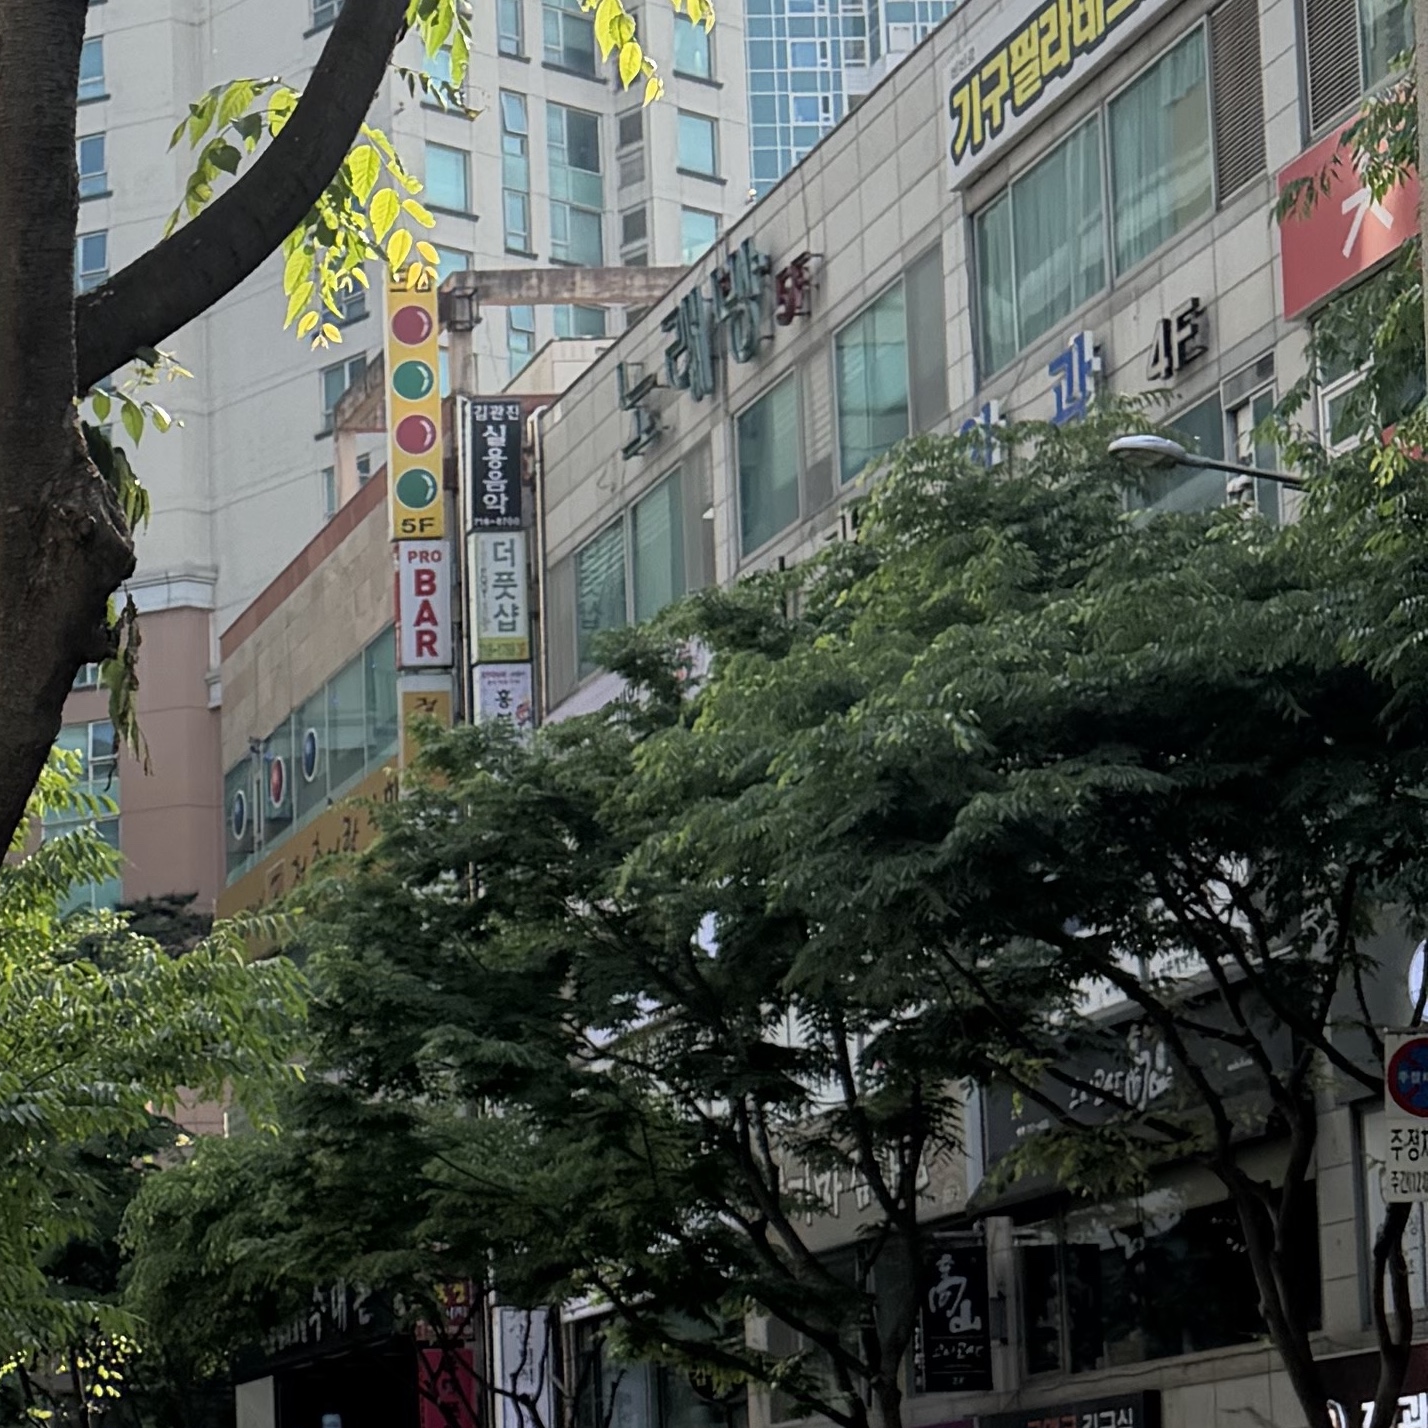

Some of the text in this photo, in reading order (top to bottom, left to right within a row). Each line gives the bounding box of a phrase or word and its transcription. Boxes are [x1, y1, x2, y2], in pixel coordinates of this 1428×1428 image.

[482, 423, 510, 515] 실용음악
[400, 517, 436, 534] 5F
[407, 550, 443, 564] PRO
[412, 568, 440, 659] BAR
